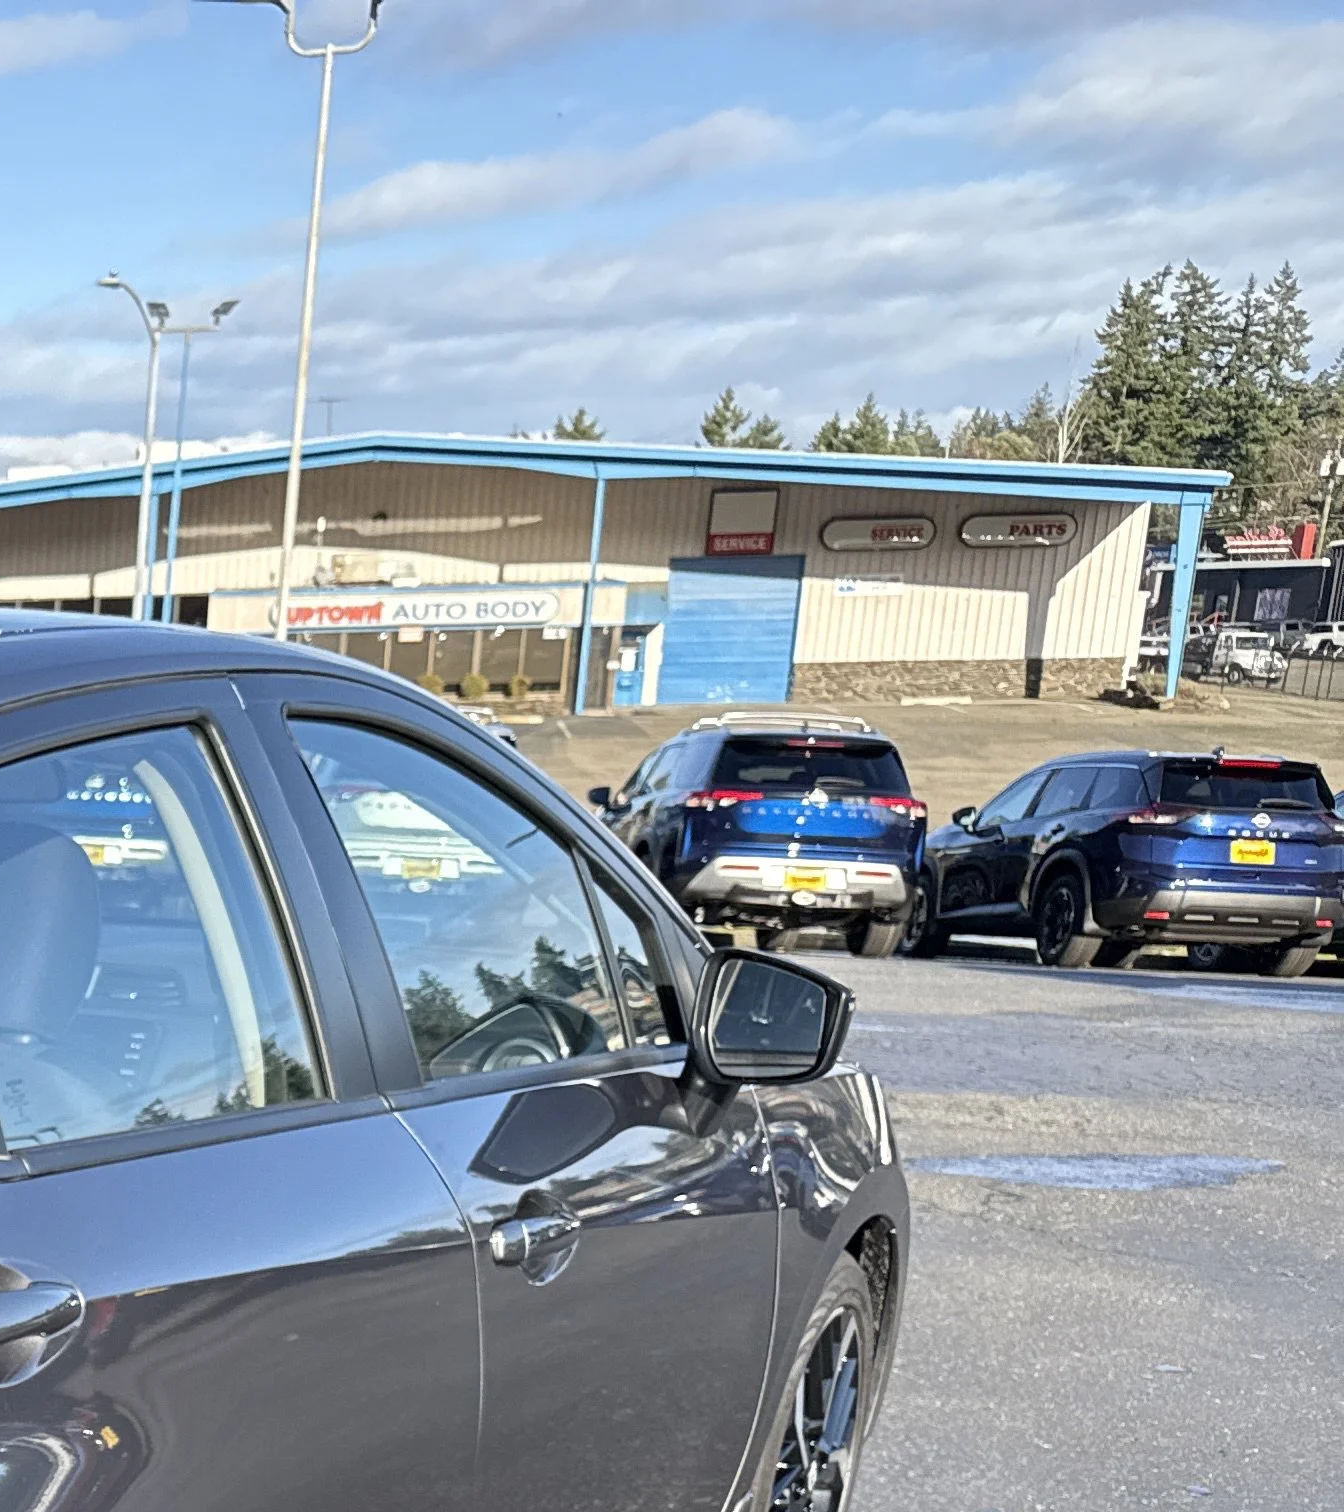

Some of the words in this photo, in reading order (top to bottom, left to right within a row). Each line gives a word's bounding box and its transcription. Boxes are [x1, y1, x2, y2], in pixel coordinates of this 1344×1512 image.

[1008, 523, 1067, 537] PARTS
[287, 600, 384, 624] UPTOWN
[392, 602, 466, 620] AUTO
[475, 599, 547, 619] BODY
